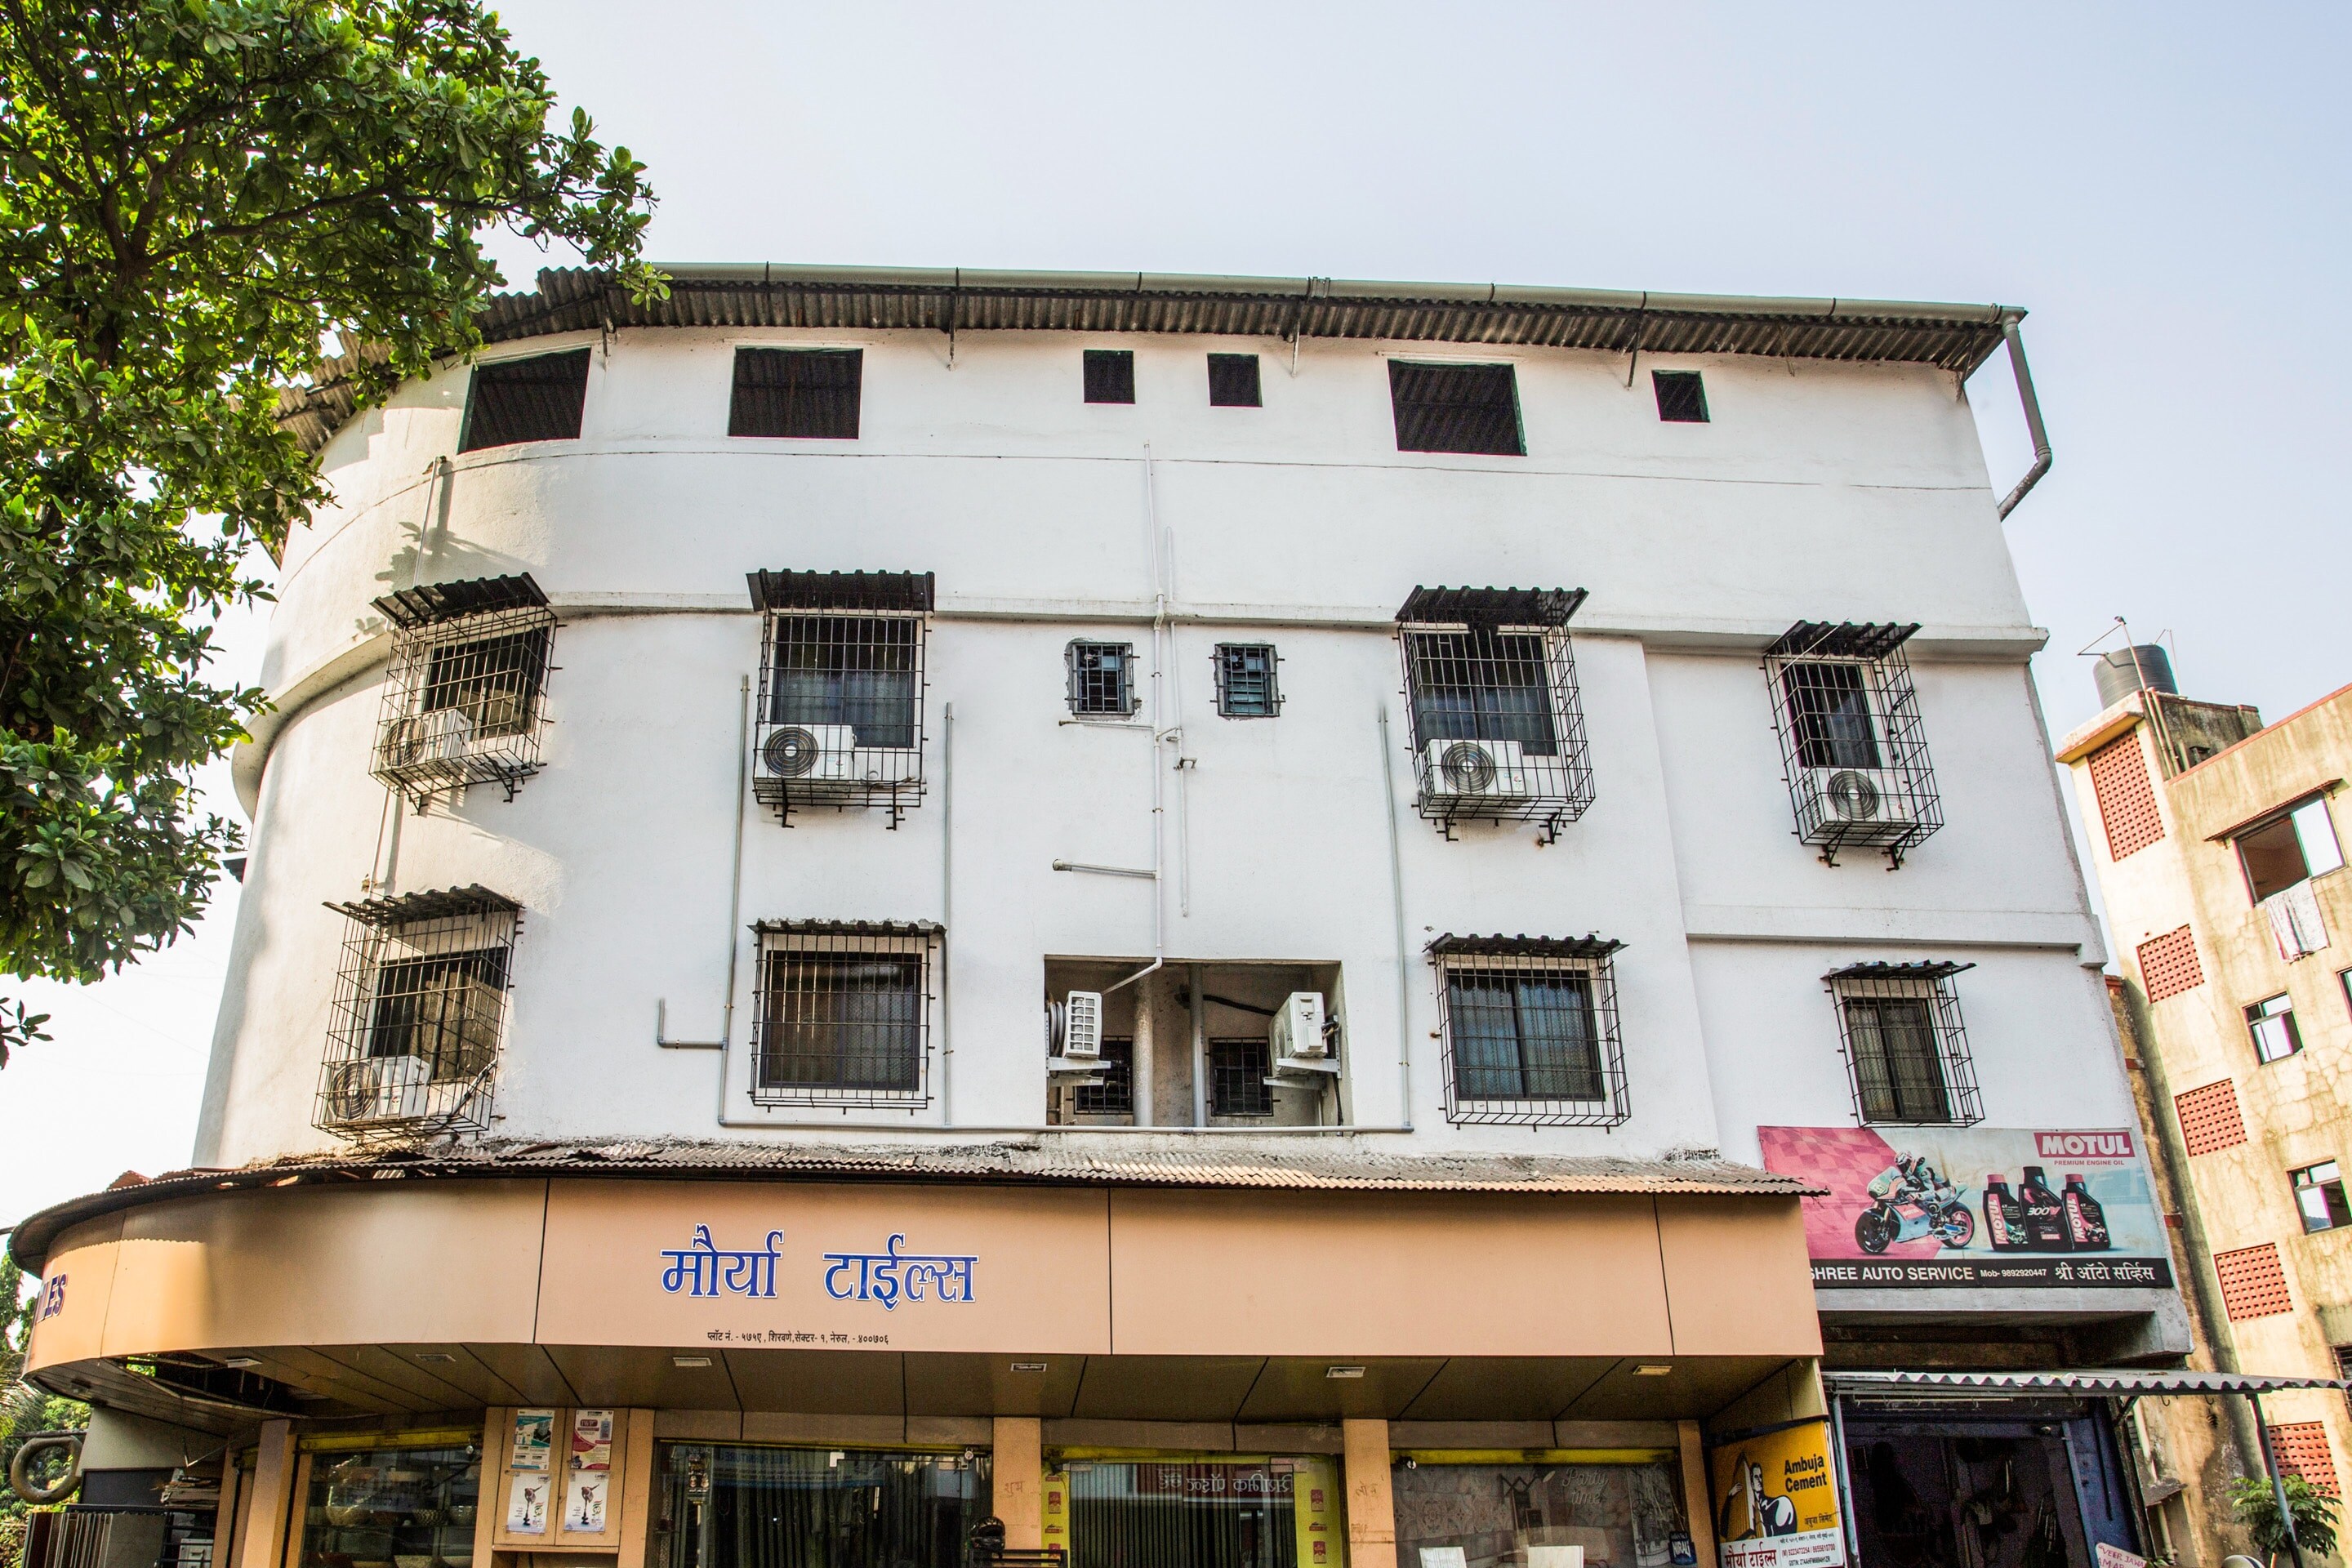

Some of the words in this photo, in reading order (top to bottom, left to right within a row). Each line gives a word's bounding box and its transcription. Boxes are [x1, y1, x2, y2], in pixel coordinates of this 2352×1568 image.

[2042, 1134, 2131, 1156] MOTUL
[1988, 1199, 2009, 1243] MOTUL
[2027, 1205, 2062, 1217] 300V
[2067, 1198, 2088, 1241] MOTUL
[660, 1223, 785, 1299] मौर्या
[822, 1232, 980, 1312] टाईल्स
[1862, 1267, 1904, 1281] AUTO
[1908, 1267, 1975, 1281] SERVICE
[2001, 1268, 2047, 1277] 9892920447
[2055, 1262, 2074, 1281] श्री
[2077, 1262, 2111, 1281] ऑटो
[707, 1330, 724, 1342] प्लॉट
[1784, 1454, 1824, 1475] Ambuja
[1562, 1467, 1610, 1490] Party
[1785, 1472, 1828, 1493] Cement
[1571, 1489, 1601, 1505] time
[2124, 1555, 2145, 1567] JAWA
